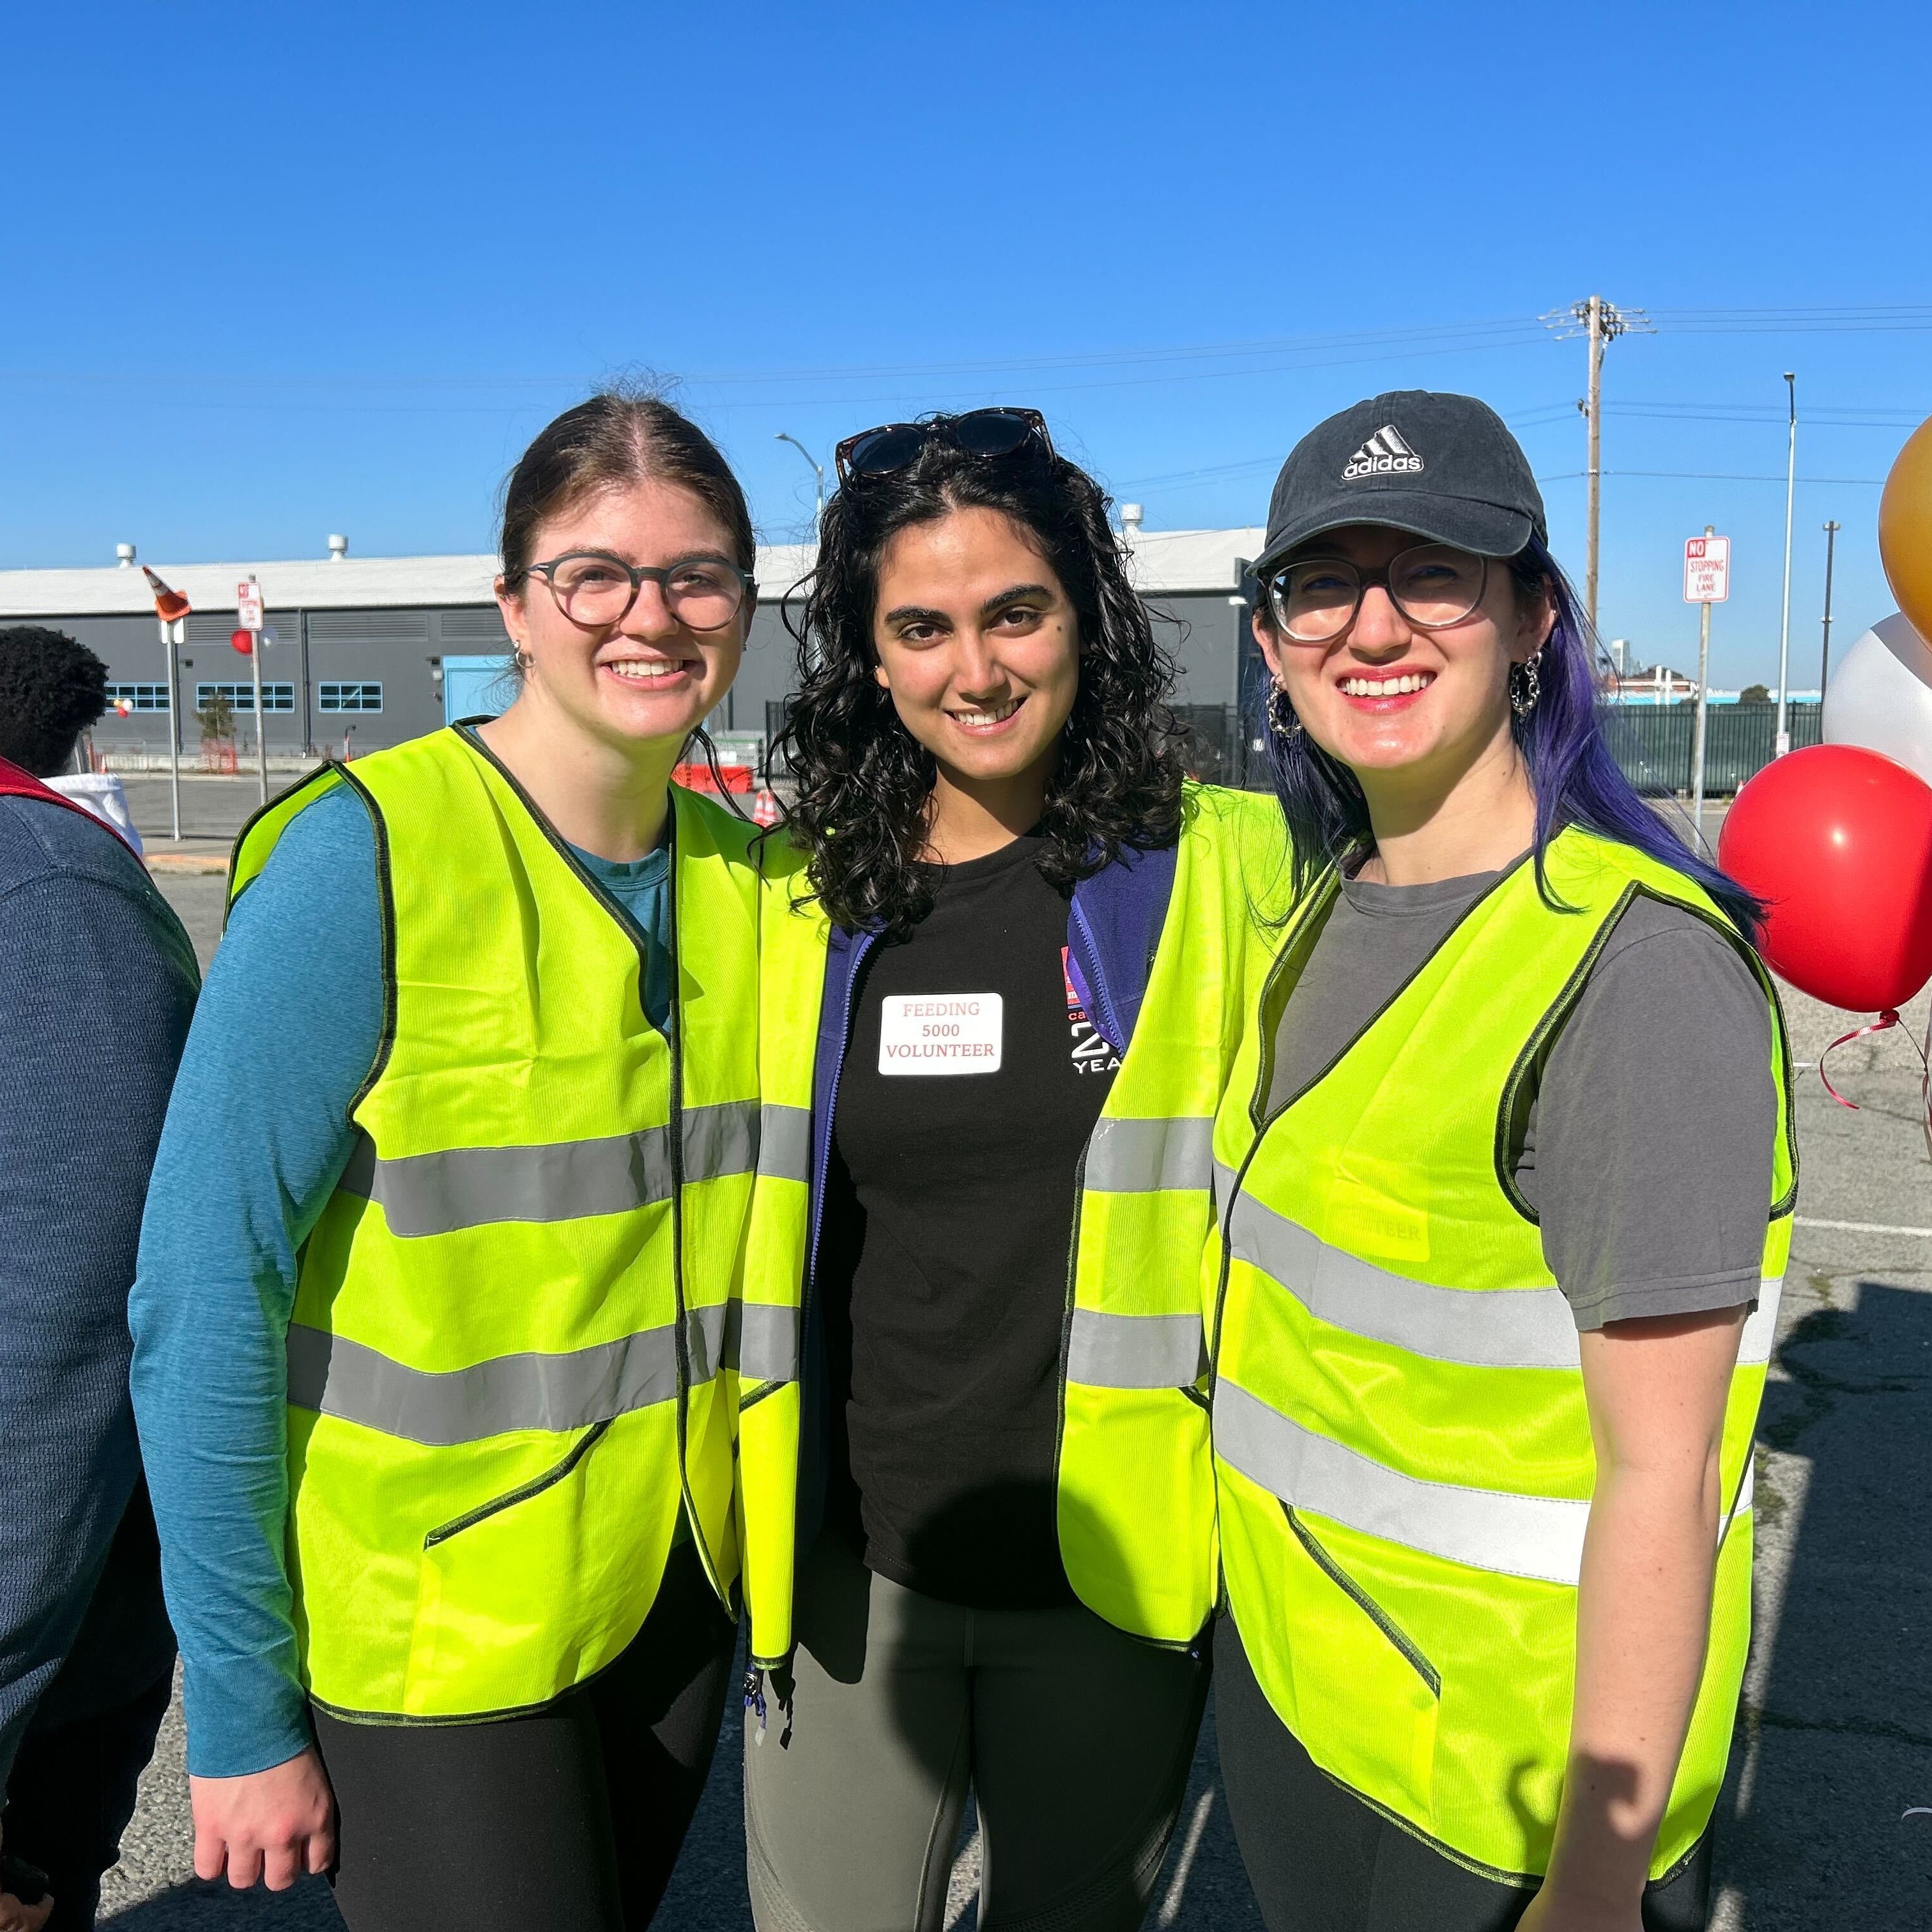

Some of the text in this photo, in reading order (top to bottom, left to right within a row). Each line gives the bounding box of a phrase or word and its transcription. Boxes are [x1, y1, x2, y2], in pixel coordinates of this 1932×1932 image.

[1344, 454, 1420, 477] adidas
[1689, 541, 1704, 556] NO
[1690, 560, 1724, 572] STOPPING
[1696, 583, 1715, 592] LANE
[903, 1002, 980, 1017] FEEDING
[922, 1024, 960, 1036] 5000
[886, 1044, 995, 1057] VOLUNTEER
